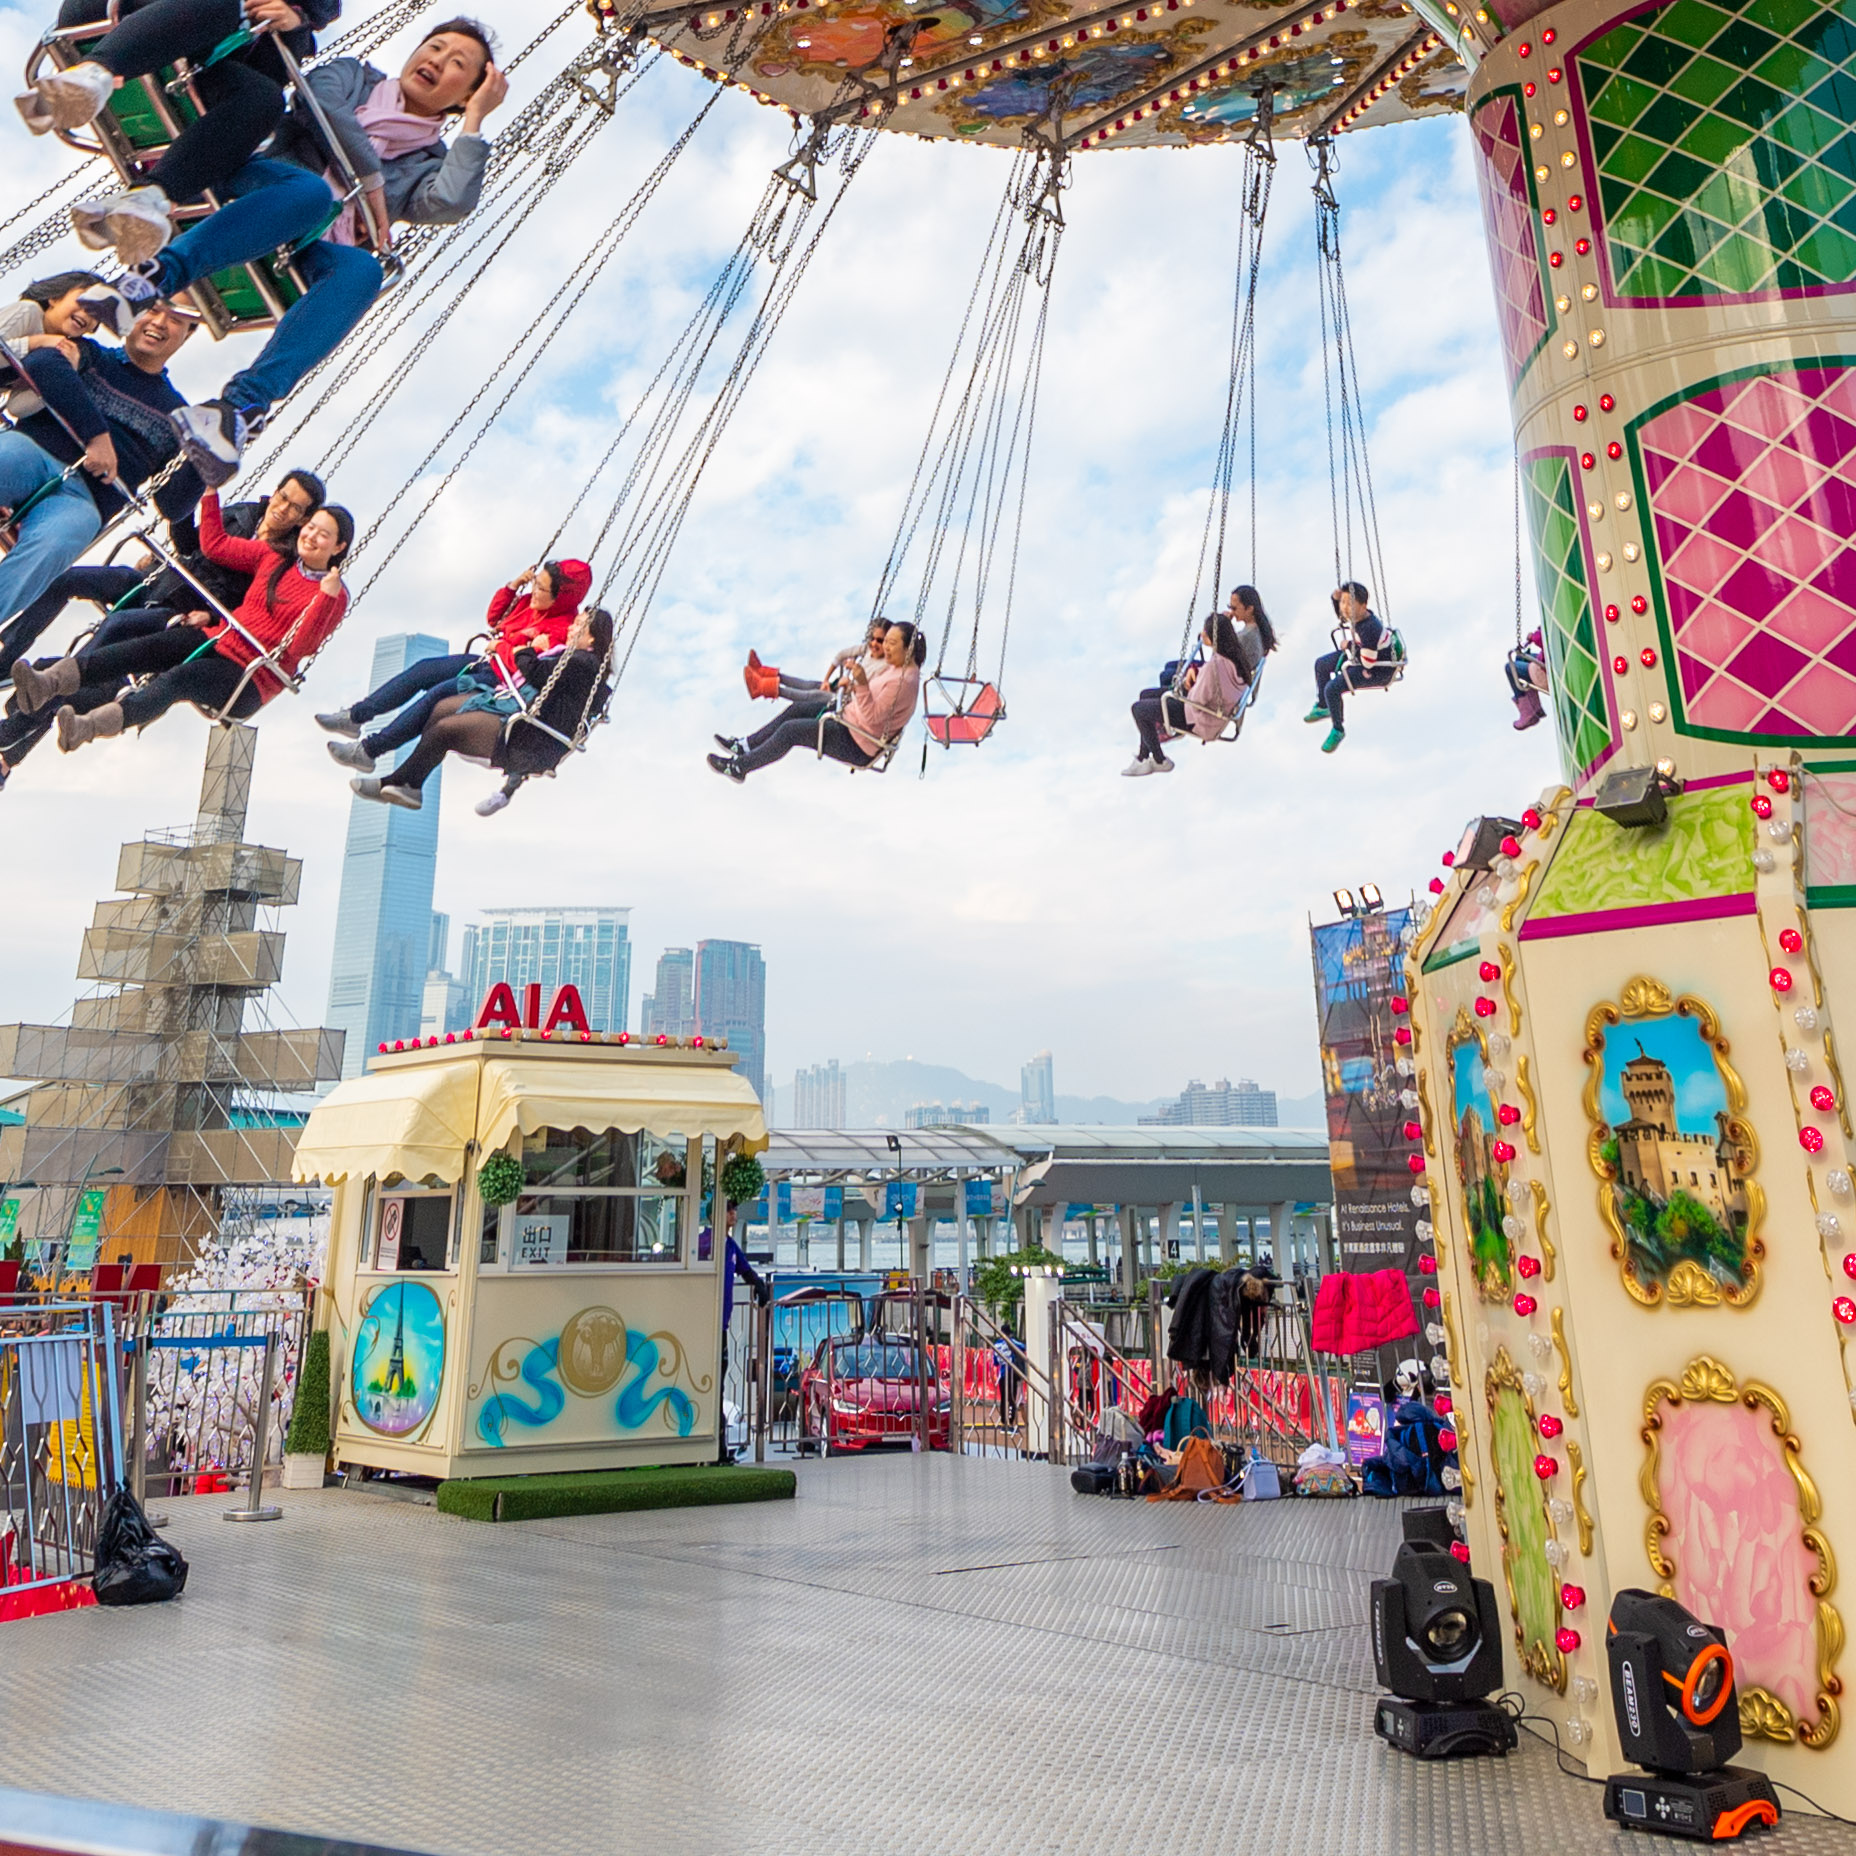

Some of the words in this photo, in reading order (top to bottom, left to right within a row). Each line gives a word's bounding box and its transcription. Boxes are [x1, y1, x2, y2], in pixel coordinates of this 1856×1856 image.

[472, 981, 590, 1031] AIA
[522, 1225, 552, 1245] 出口
[521, 1246, 552, 1259] EXIT
[1170, 1240, 1178, 1258] 4
[1624, 1669, 1639, 1729] BEAM230
